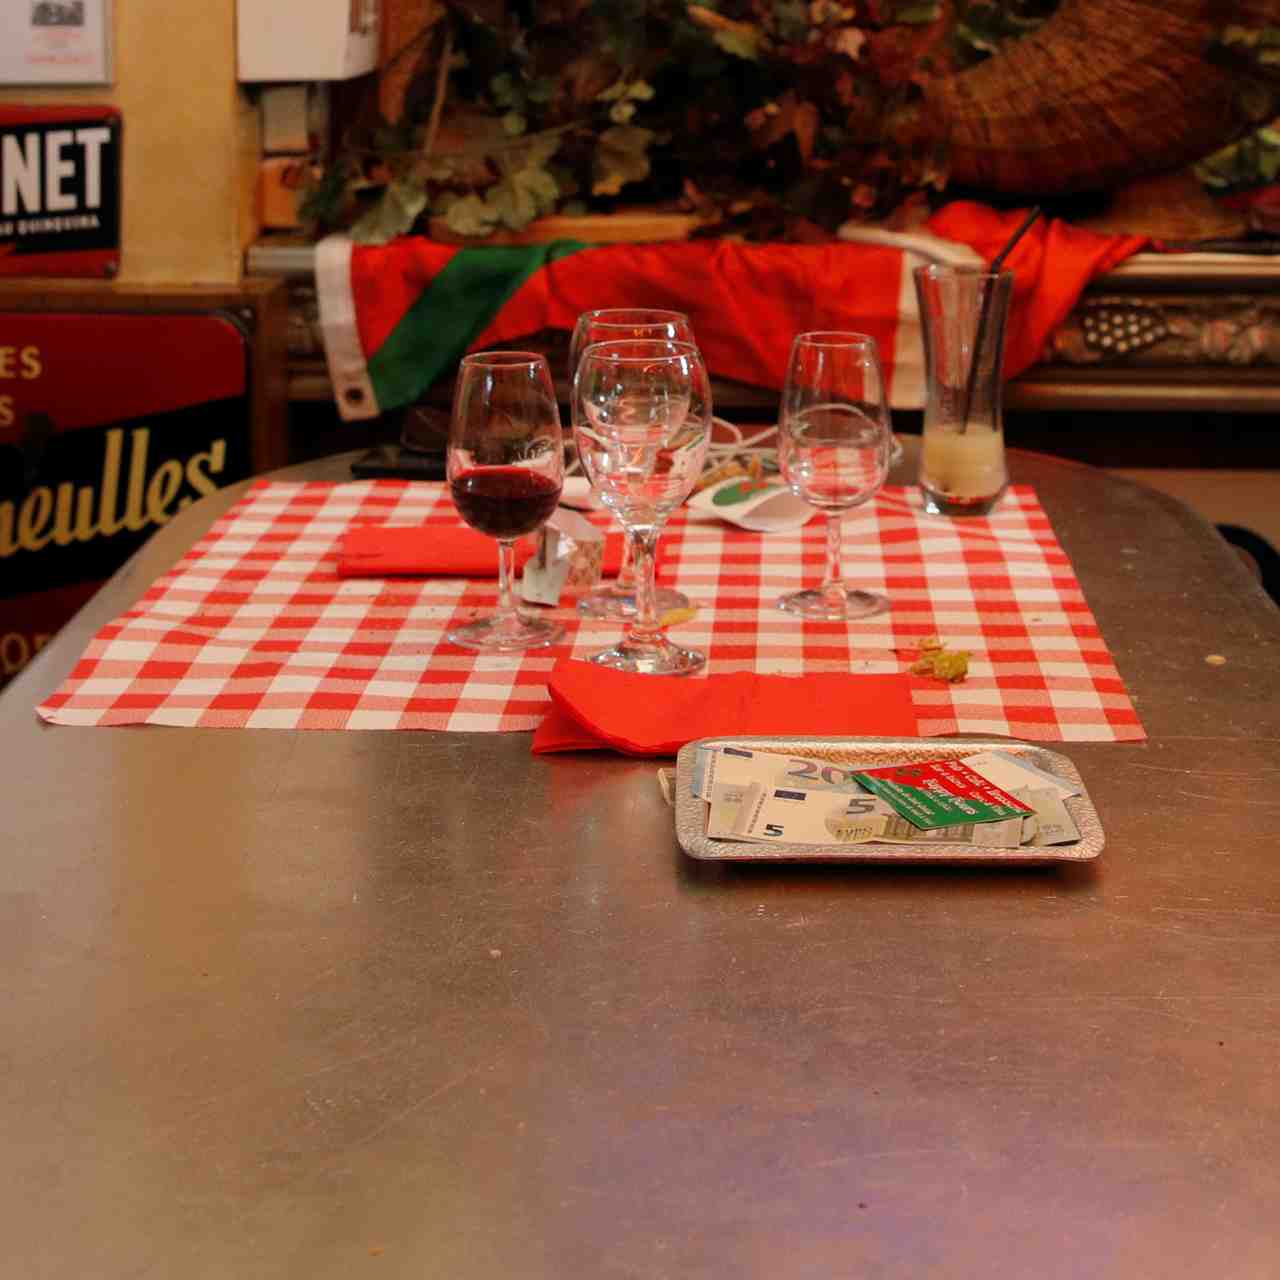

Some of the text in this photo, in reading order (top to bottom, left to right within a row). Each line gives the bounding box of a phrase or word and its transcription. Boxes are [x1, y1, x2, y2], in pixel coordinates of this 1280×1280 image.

[787, 757, 852, 785] 20
[845, 797, 877, 815] 5
[762, 823, 785, 838] 5
